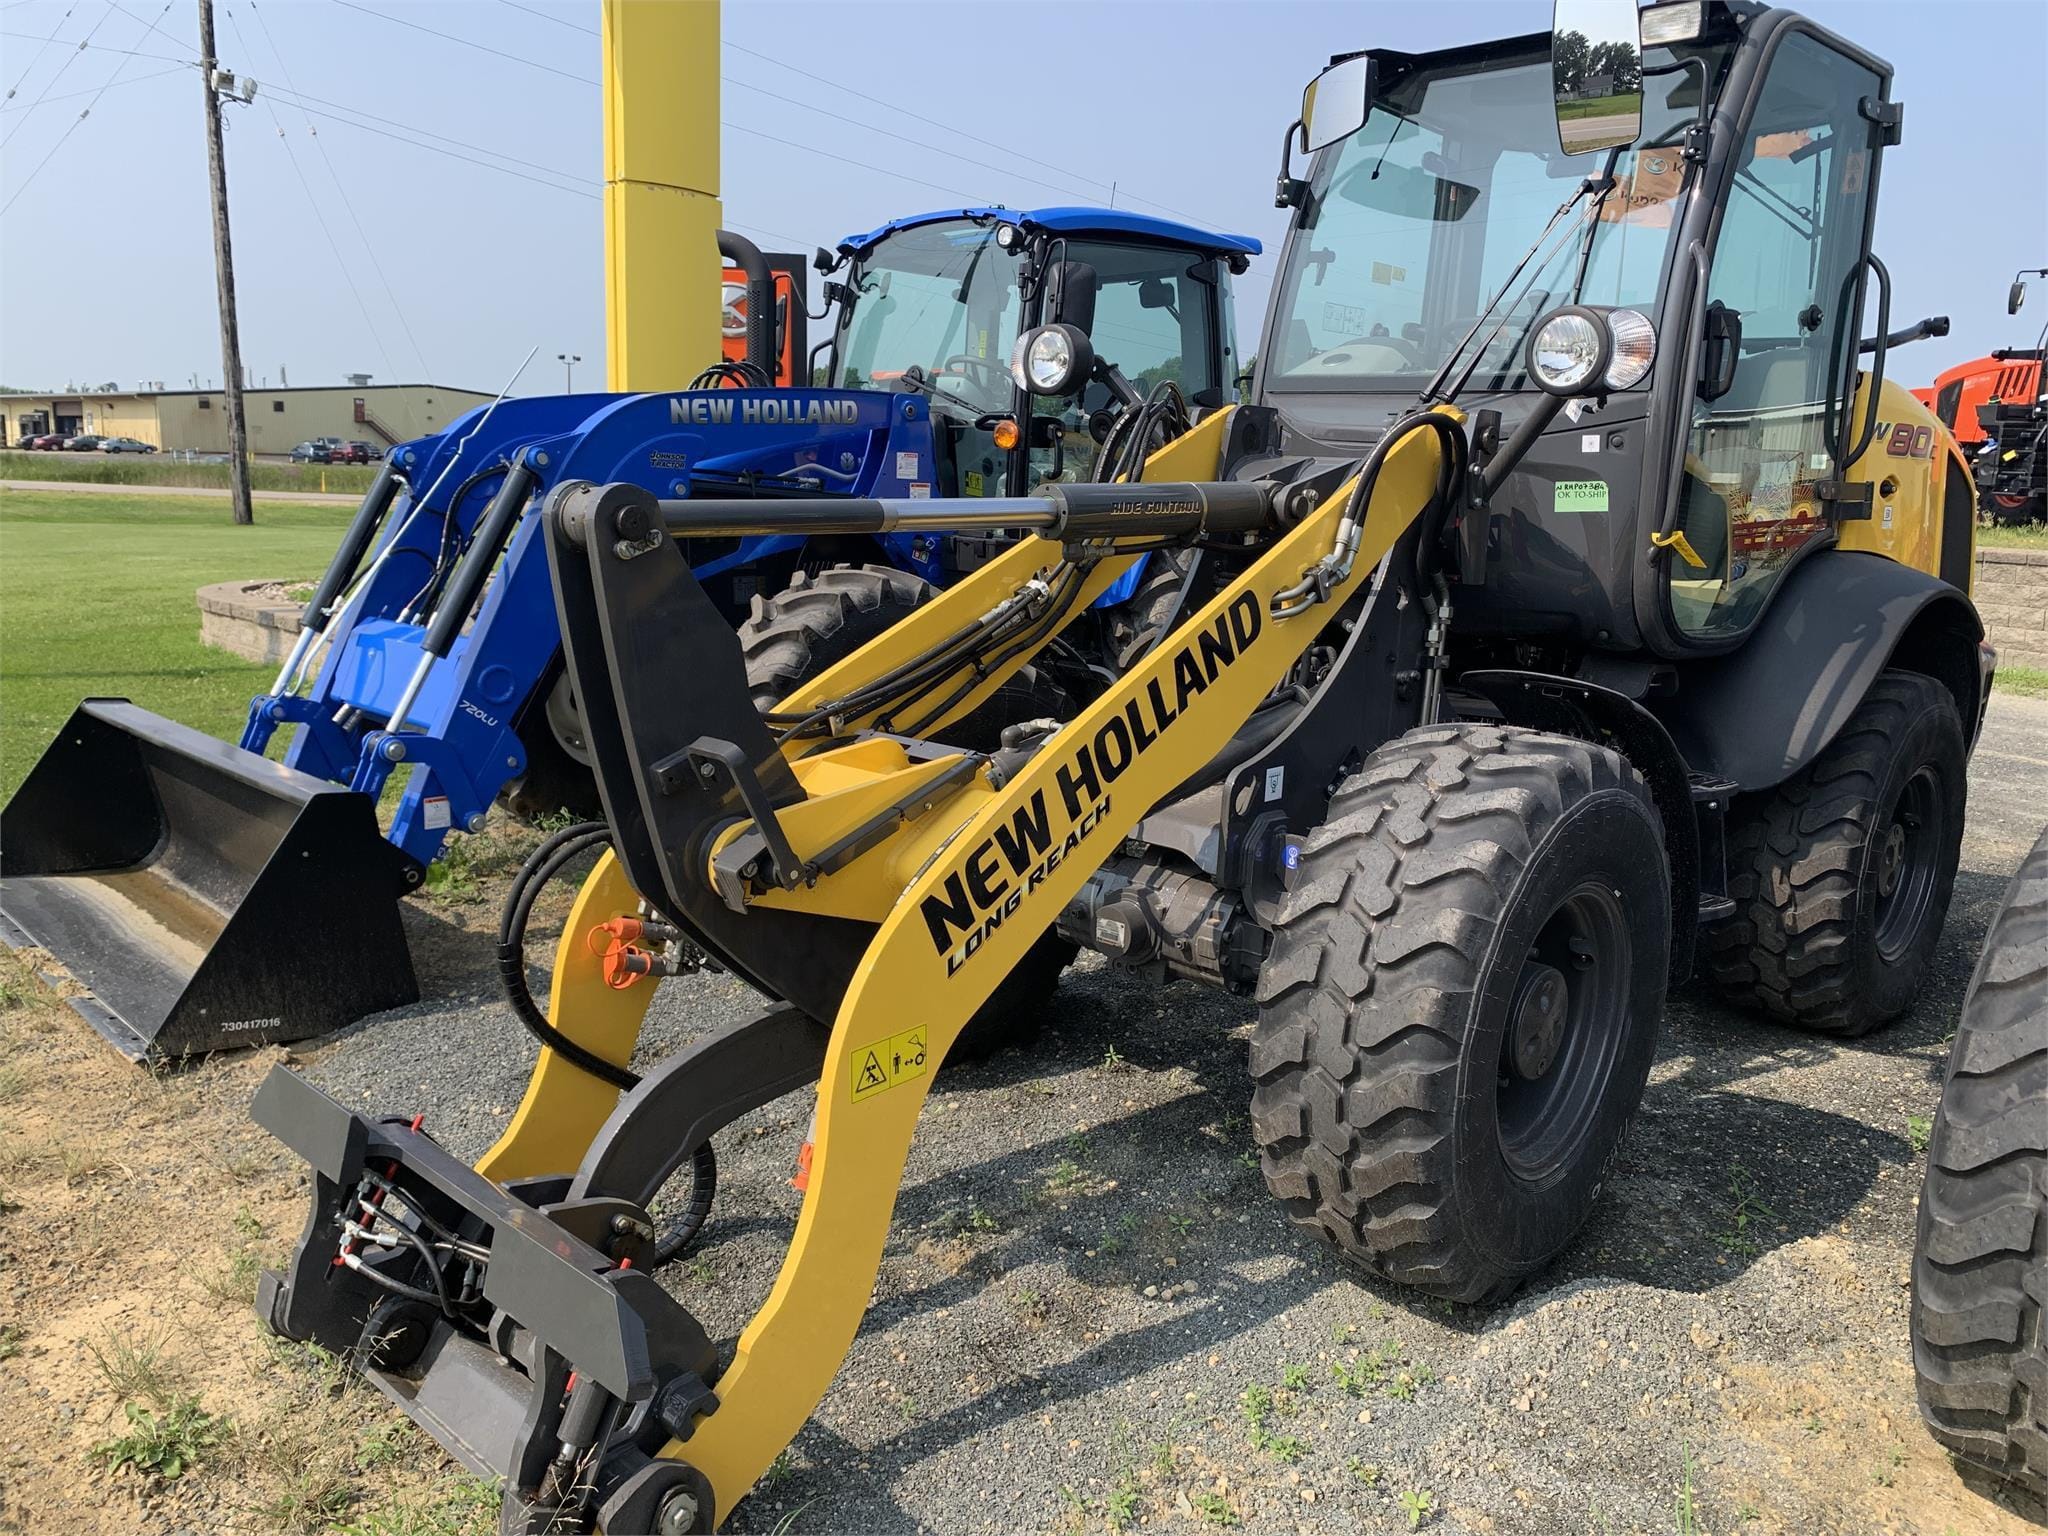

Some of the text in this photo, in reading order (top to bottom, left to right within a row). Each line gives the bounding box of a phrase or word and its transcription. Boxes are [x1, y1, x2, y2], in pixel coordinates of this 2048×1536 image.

[670, 399, 858, 424] NEW HOLLAND
[650, 450, 686, 460] JOHNSON
[650, 459, 686, 469] TRACTOR
[1557, 491, 1571, 499] OK
[1110, 501, 1201, 515] RIDE CONTROL
[458, 699, 499, 727] 720LU
[920, 589, 1262, 957] NEW HOLLAND
[947, 887, 1023, 979] LONG
[1028, 793, 1111, 896] REACH
[220, 1017, 281, 1032] 730417016
